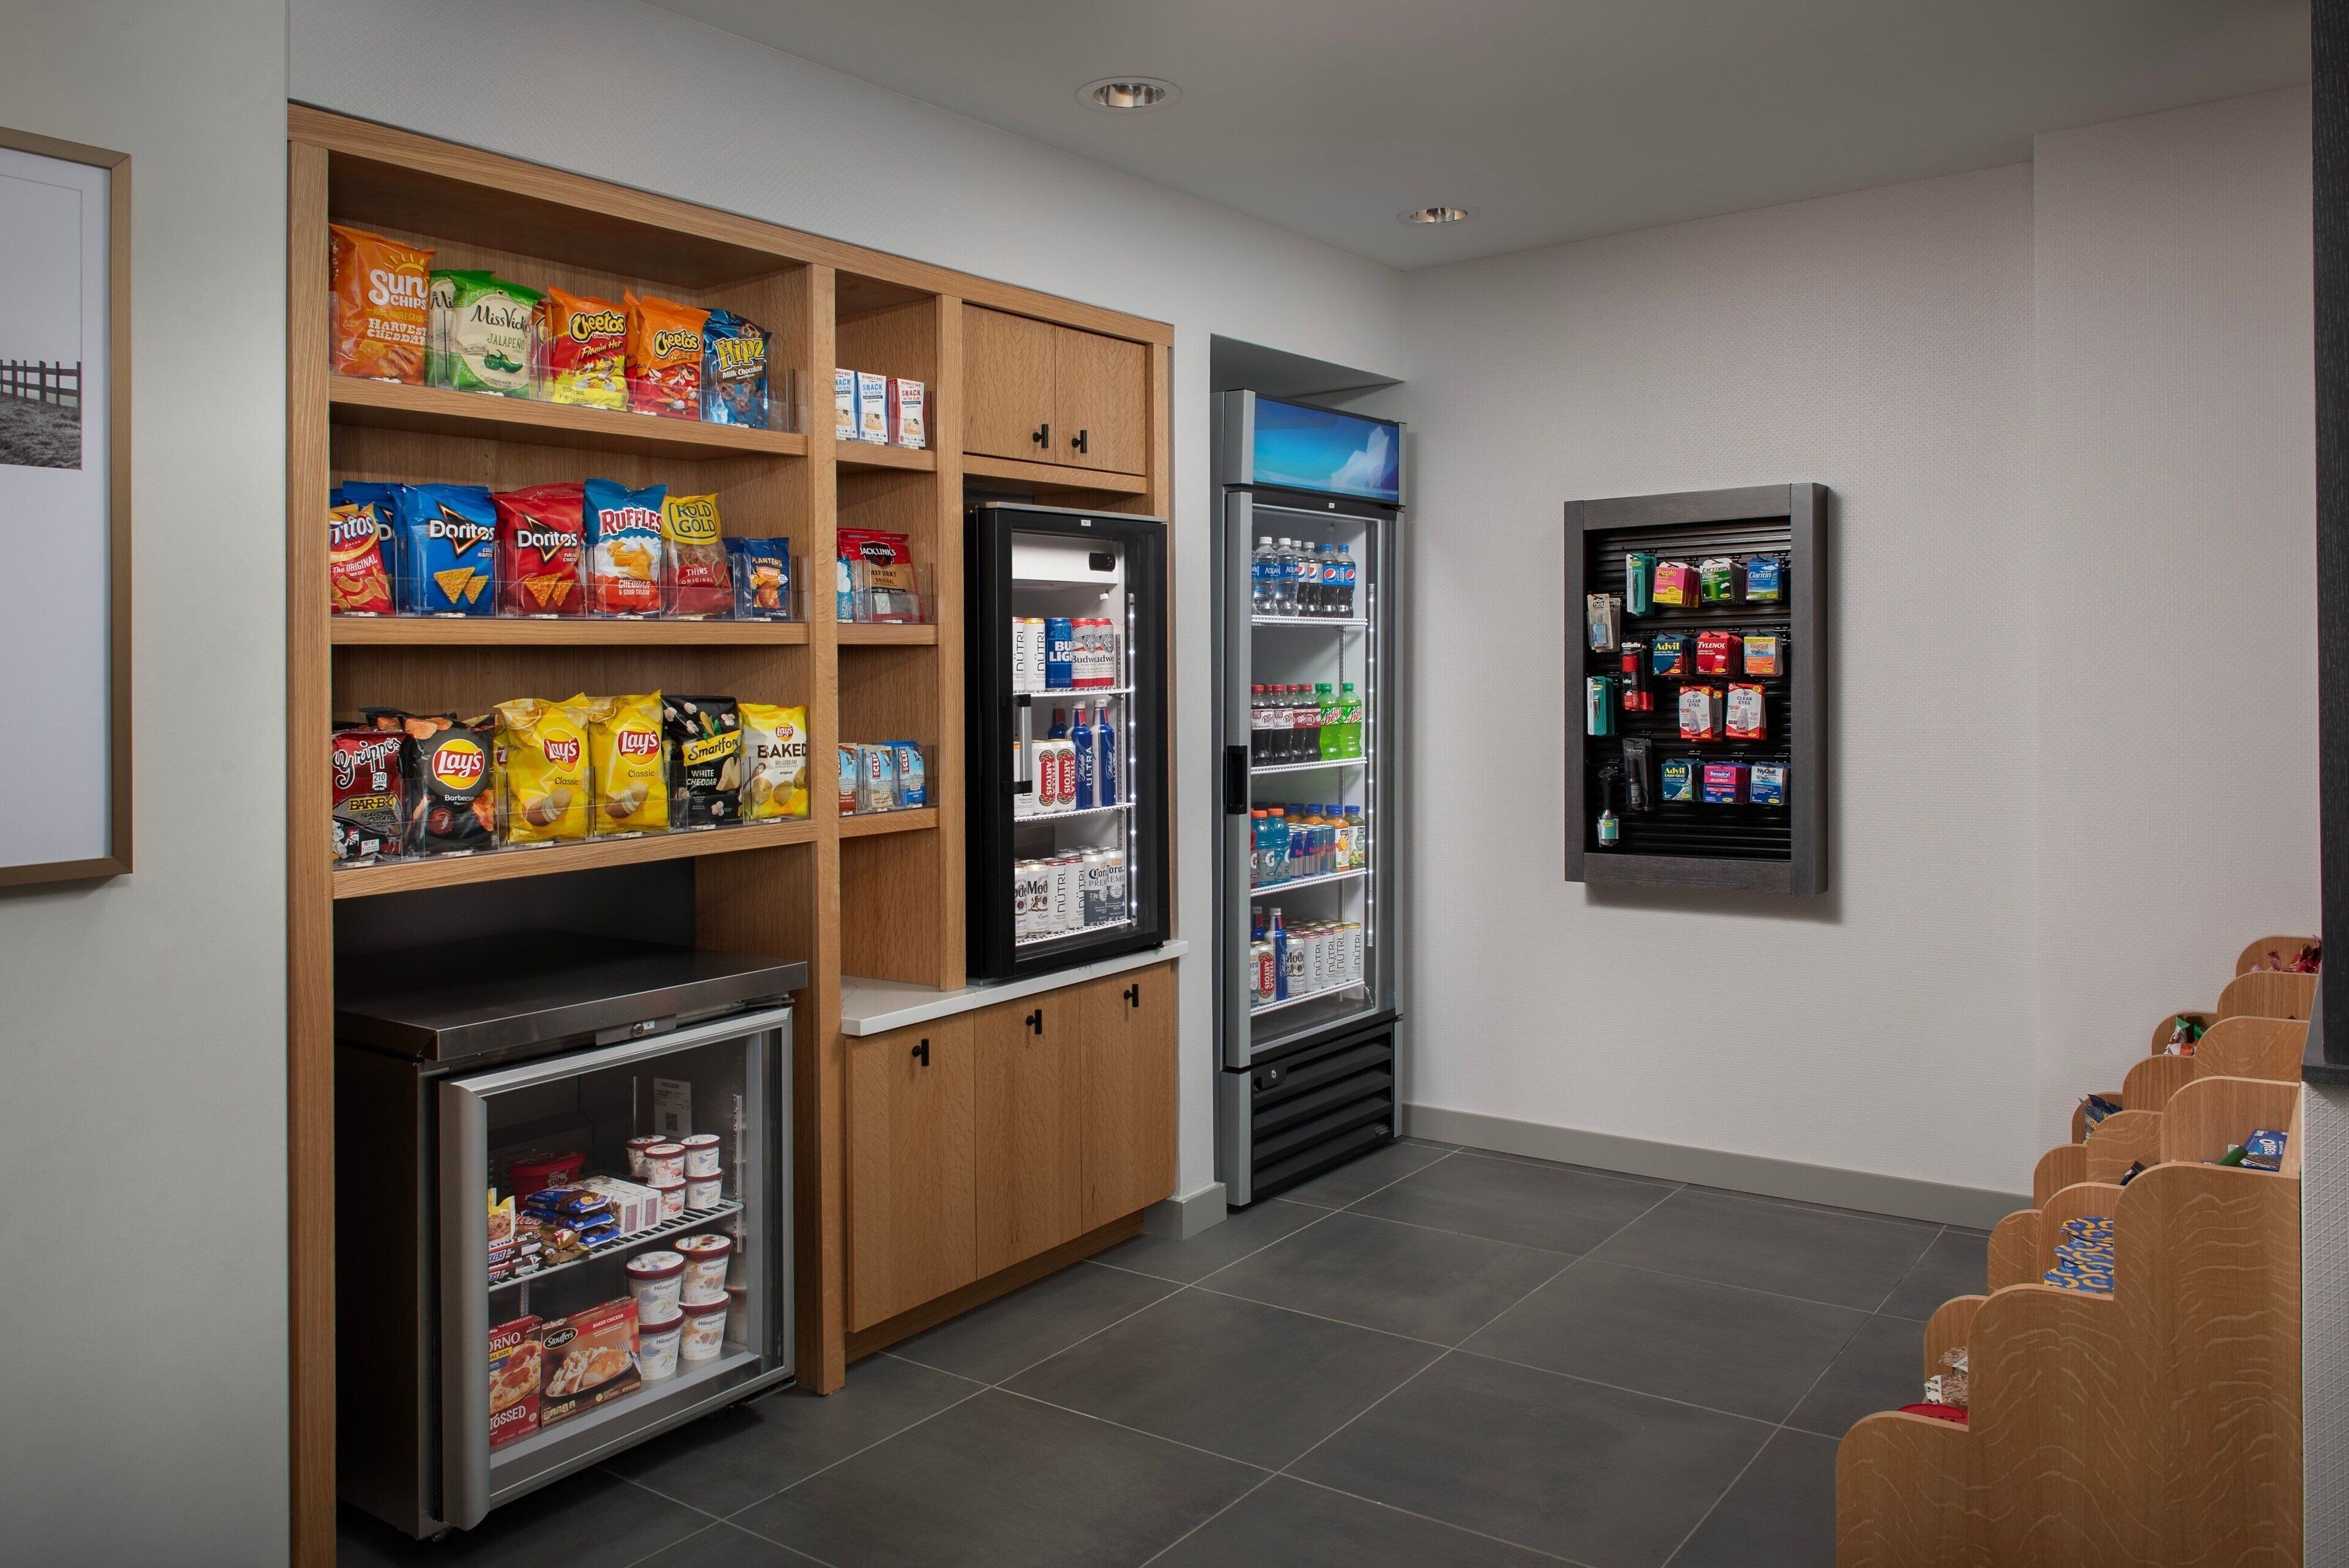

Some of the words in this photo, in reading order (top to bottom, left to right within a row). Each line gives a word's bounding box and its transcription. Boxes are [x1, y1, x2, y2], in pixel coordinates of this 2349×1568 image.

[368, 269, 428, 305] Sun
[390, 294, 426, 310] CHIPS
[373, 307, 388, 316] 100%
[389, 311, 407, 320] WHOLE
[409, 313, 425, 323] GRAIN
[470, 305, 505, 327] Miss
[368, 318, 426, 336] HARVEST
[570, 310, 626, 343] Cheetos
[488, 333, 525, 351] JALAPEÑO
[608, 340, 623, 349] Hot
[655, 329, 700, 359] Cheetos
[669, 351, 692, 362] Crunchy
[715, 338, 764, 371] Flipz
[722, 370, 737, 379] Milk
[738, 365, 763, 376] Chocolate
[677, 502, 711, 518] ROLD
[600, 508, 661, 535] RUFFLES
[678, 519, 716, 533] GOLD
[430, 520, 495, 541] Doritos
[518, 530, 577, 548] Doritos
[346, 554, 377, 571] ORIGINAL
[752, 557, 783, 567] PLANTERS
[686, 567, 708, 576] THINS
[1055, 641, 1072, 651] BU
[1049, 652, 1071, 661] LIG
[777, 726, 793, 738] Lay's
[546, 739, 577, 764] Lay's
[622, 732, 659, 756] Lay's
[757, 743, 806, 759] BAKED
[437, 751, 481, 778] Lay's
[554, 776, 580, 786] Classic
[2258, 1139, 2276, 1155] OREO
[547, 1330, 574, 1347] Stouffer's
